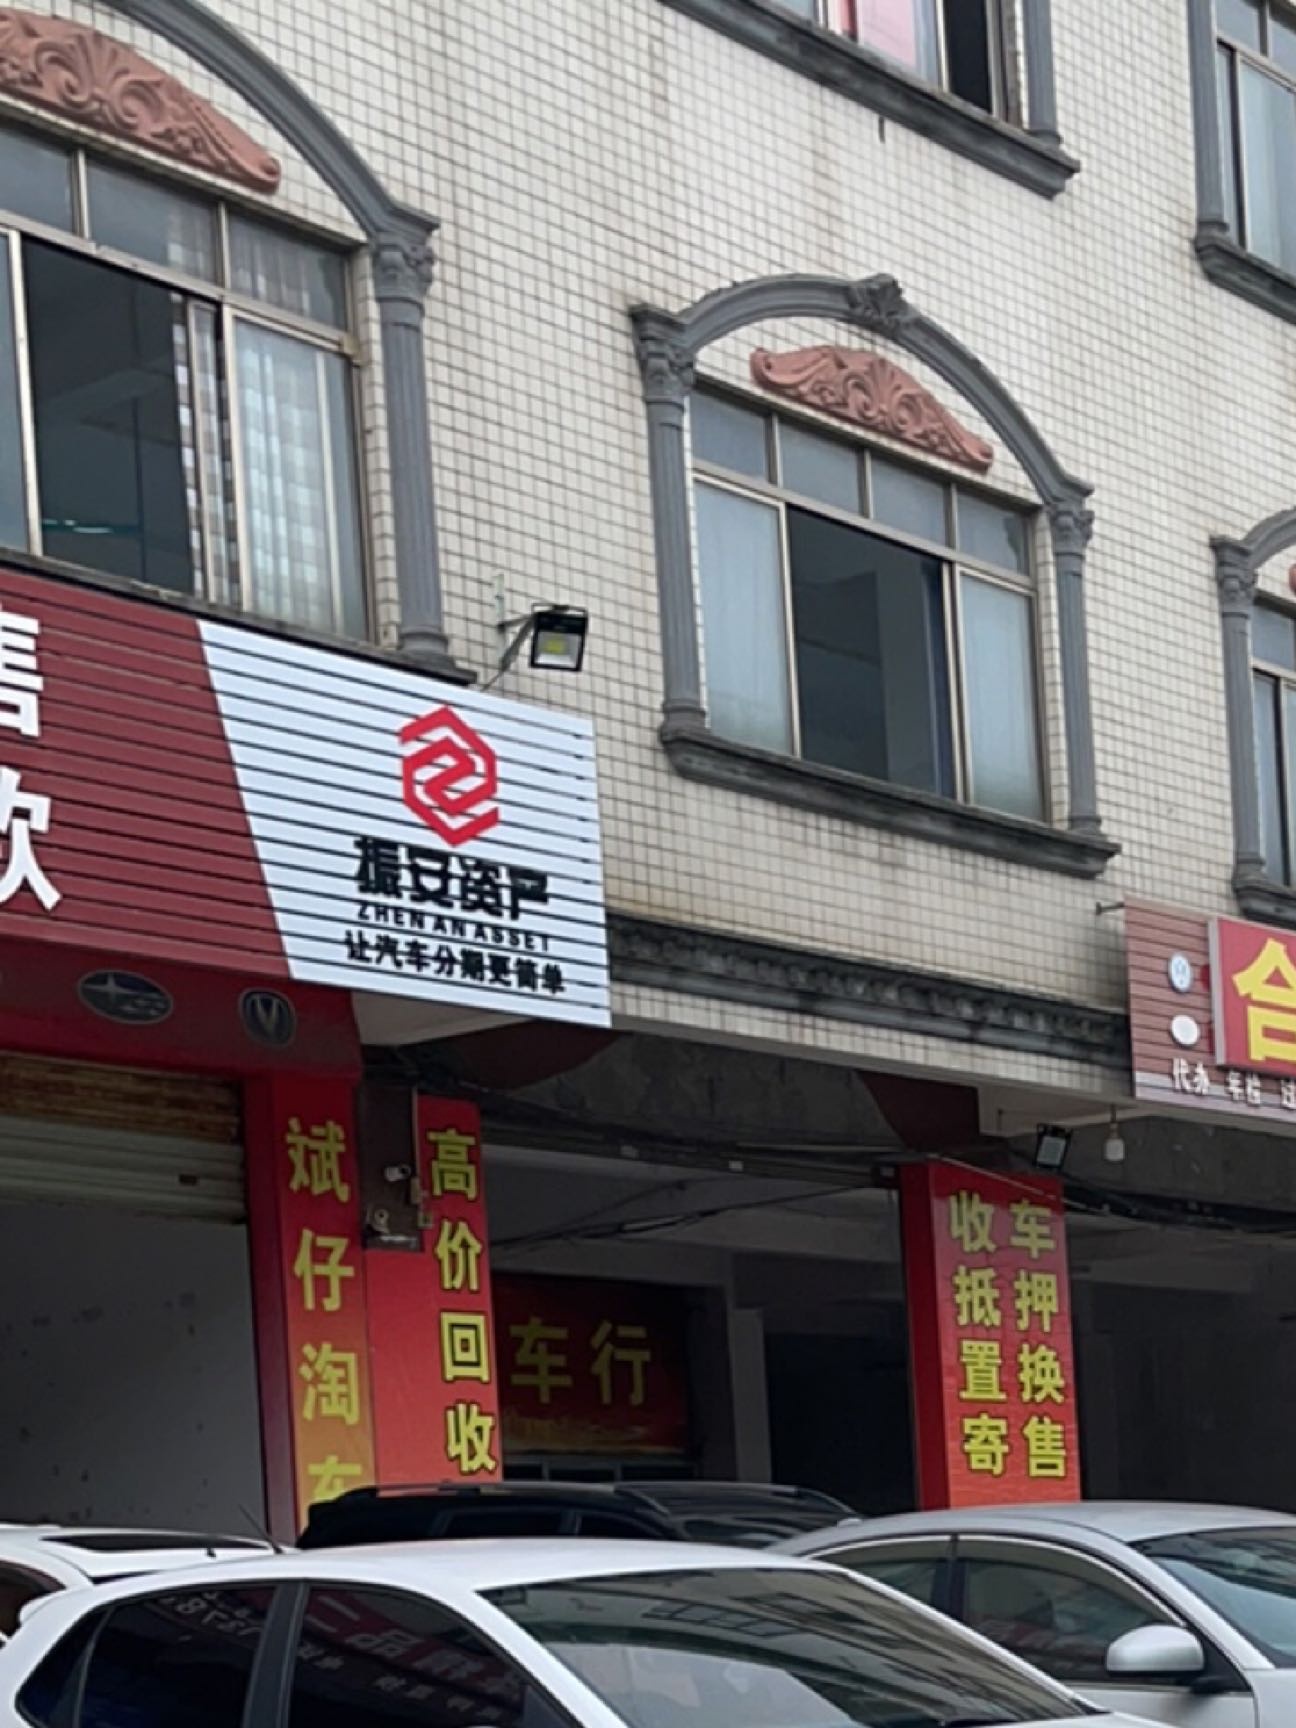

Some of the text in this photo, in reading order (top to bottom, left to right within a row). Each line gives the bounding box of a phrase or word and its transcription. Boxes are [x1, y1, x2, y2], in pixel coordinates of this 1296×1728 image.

[353, 834, 549, 921] 振安资产
[345, 930, 566, 995] 让汽车分期更简单
[357, 902, 425, 930] ZHEN
[474, 923, 550, 952] ASSET
[427, 1129, 498, 1474] 高价回收
[509, 1316, 652, 1406] 车行
